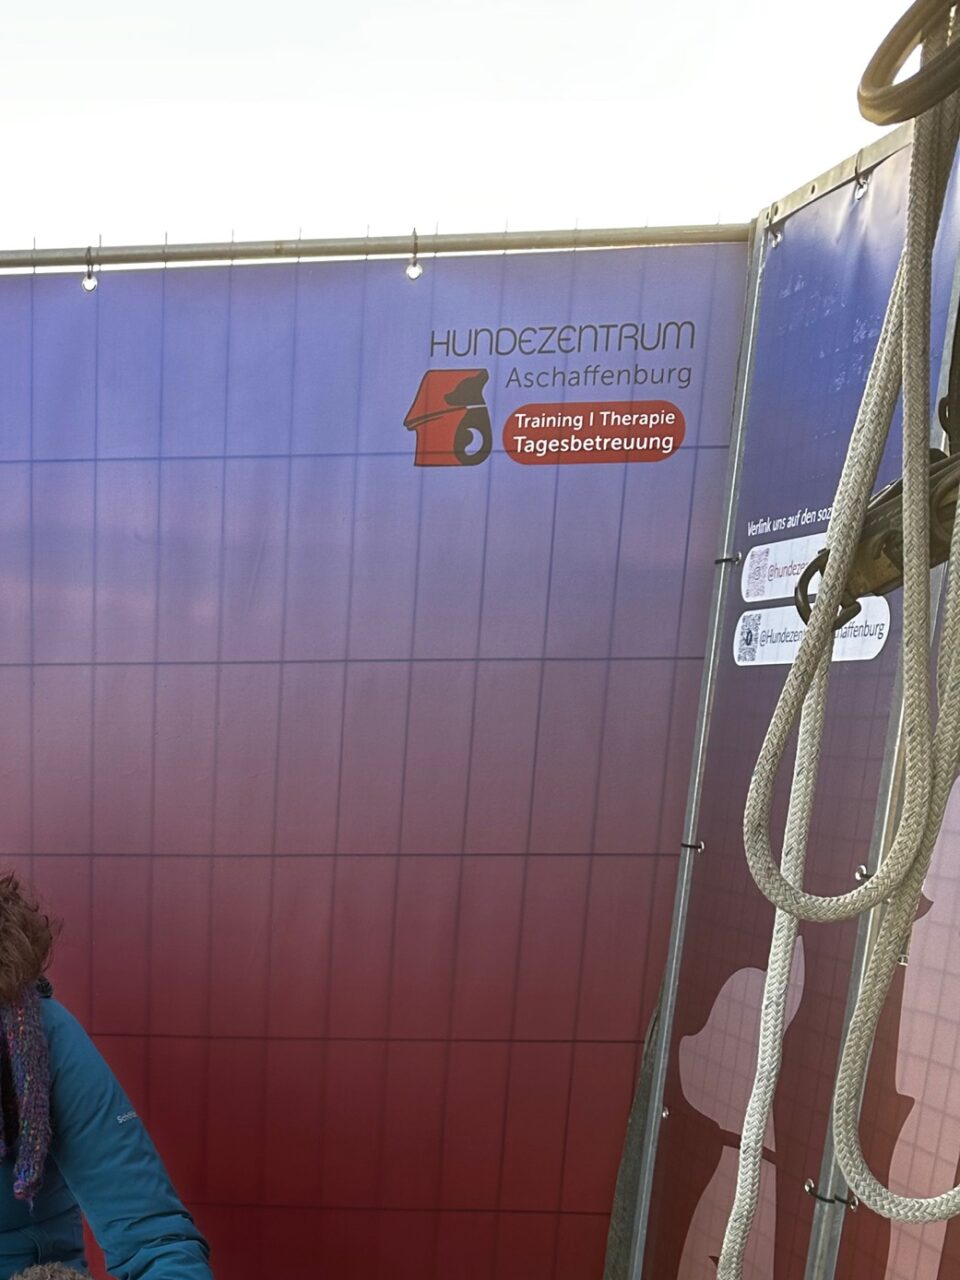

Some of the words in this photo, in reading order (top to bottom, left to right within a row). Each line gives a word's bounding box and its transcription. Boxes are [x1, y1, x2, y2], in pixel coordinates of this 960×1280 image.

[430, 320, 696, 357] HUNDEZENTRUM
[504, 363, 692, 389] Aschaffenburg
[514, 412, 583, 431] Training
[599, 409, 676, 429] Therapie
[512, 434, 674, 457] Tagesbetreuung
[772, 518, 786, 532] uns
[787, 509, 801, 529] auf
[801, 508, 817, 525] den
